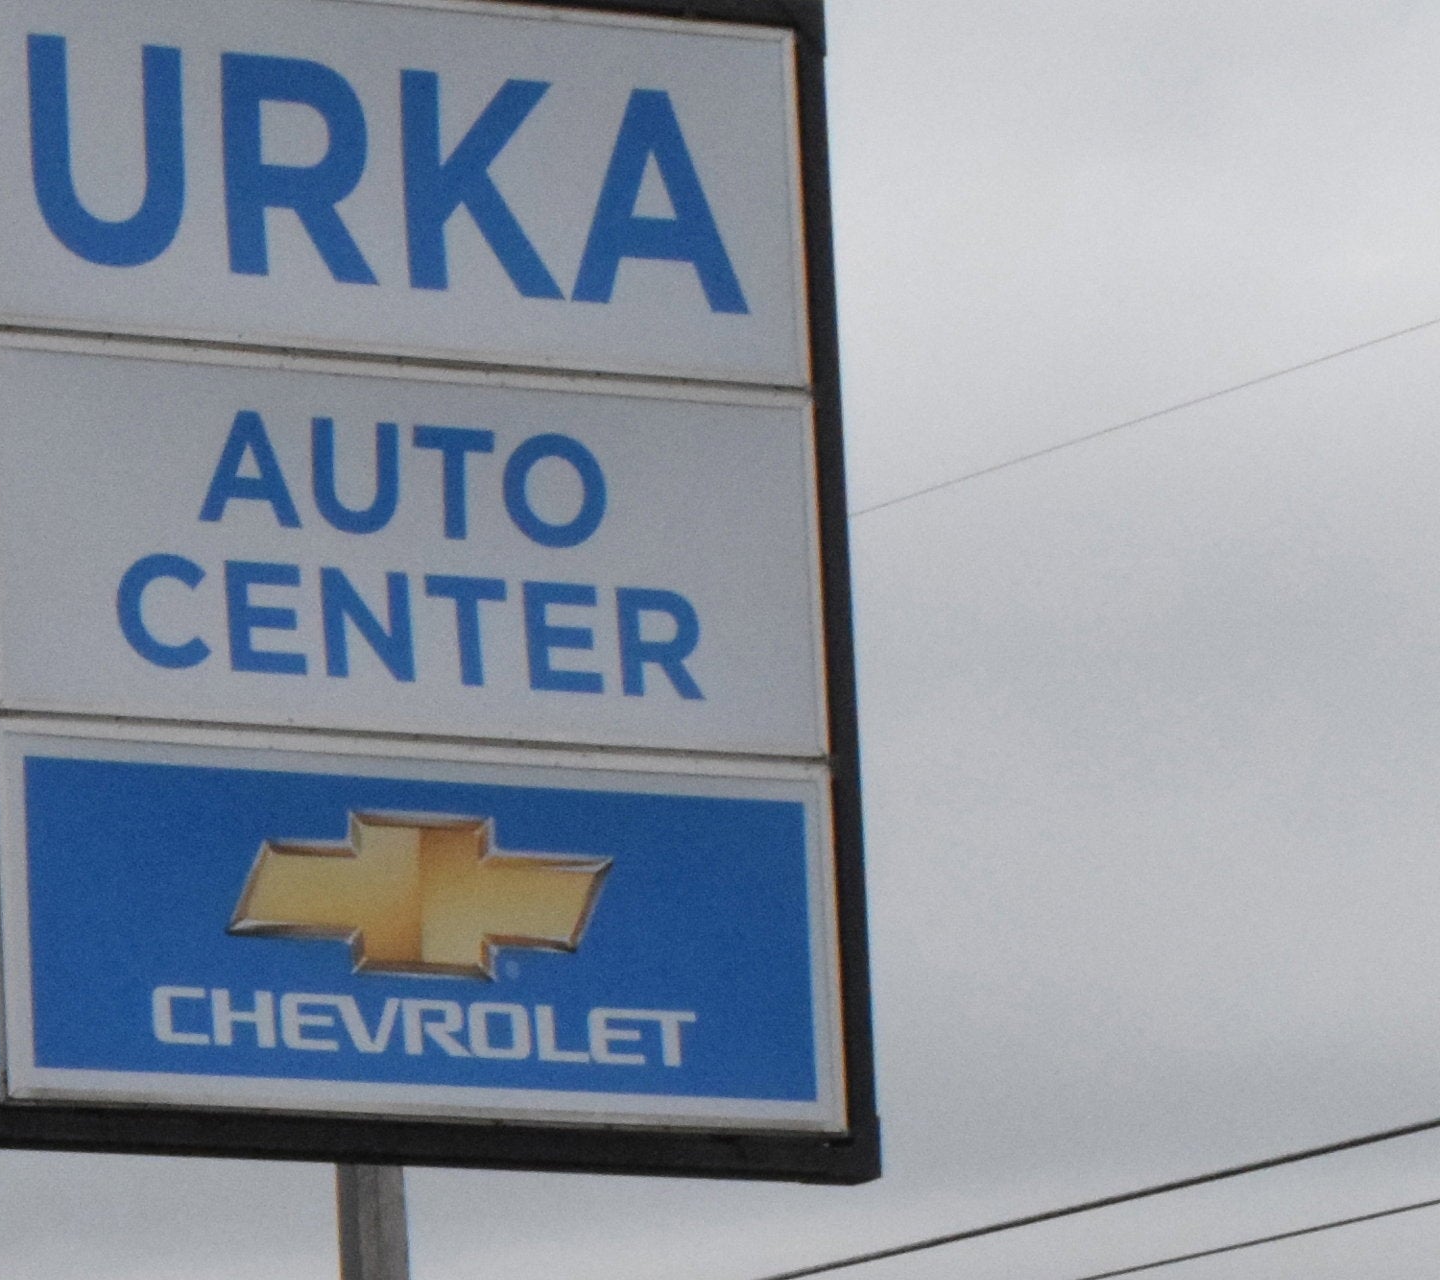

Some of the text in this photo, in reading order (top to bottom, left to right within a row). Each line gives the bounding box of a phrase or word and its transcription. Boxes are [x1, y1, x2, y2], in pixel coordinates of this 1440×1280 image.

[25, 33, 750, 315] URKA
[197, 410, 608, 548] AUTO
[115, 553, 706, 700] CENTER
[150, 984, 696, 1068] CHEVROLET
